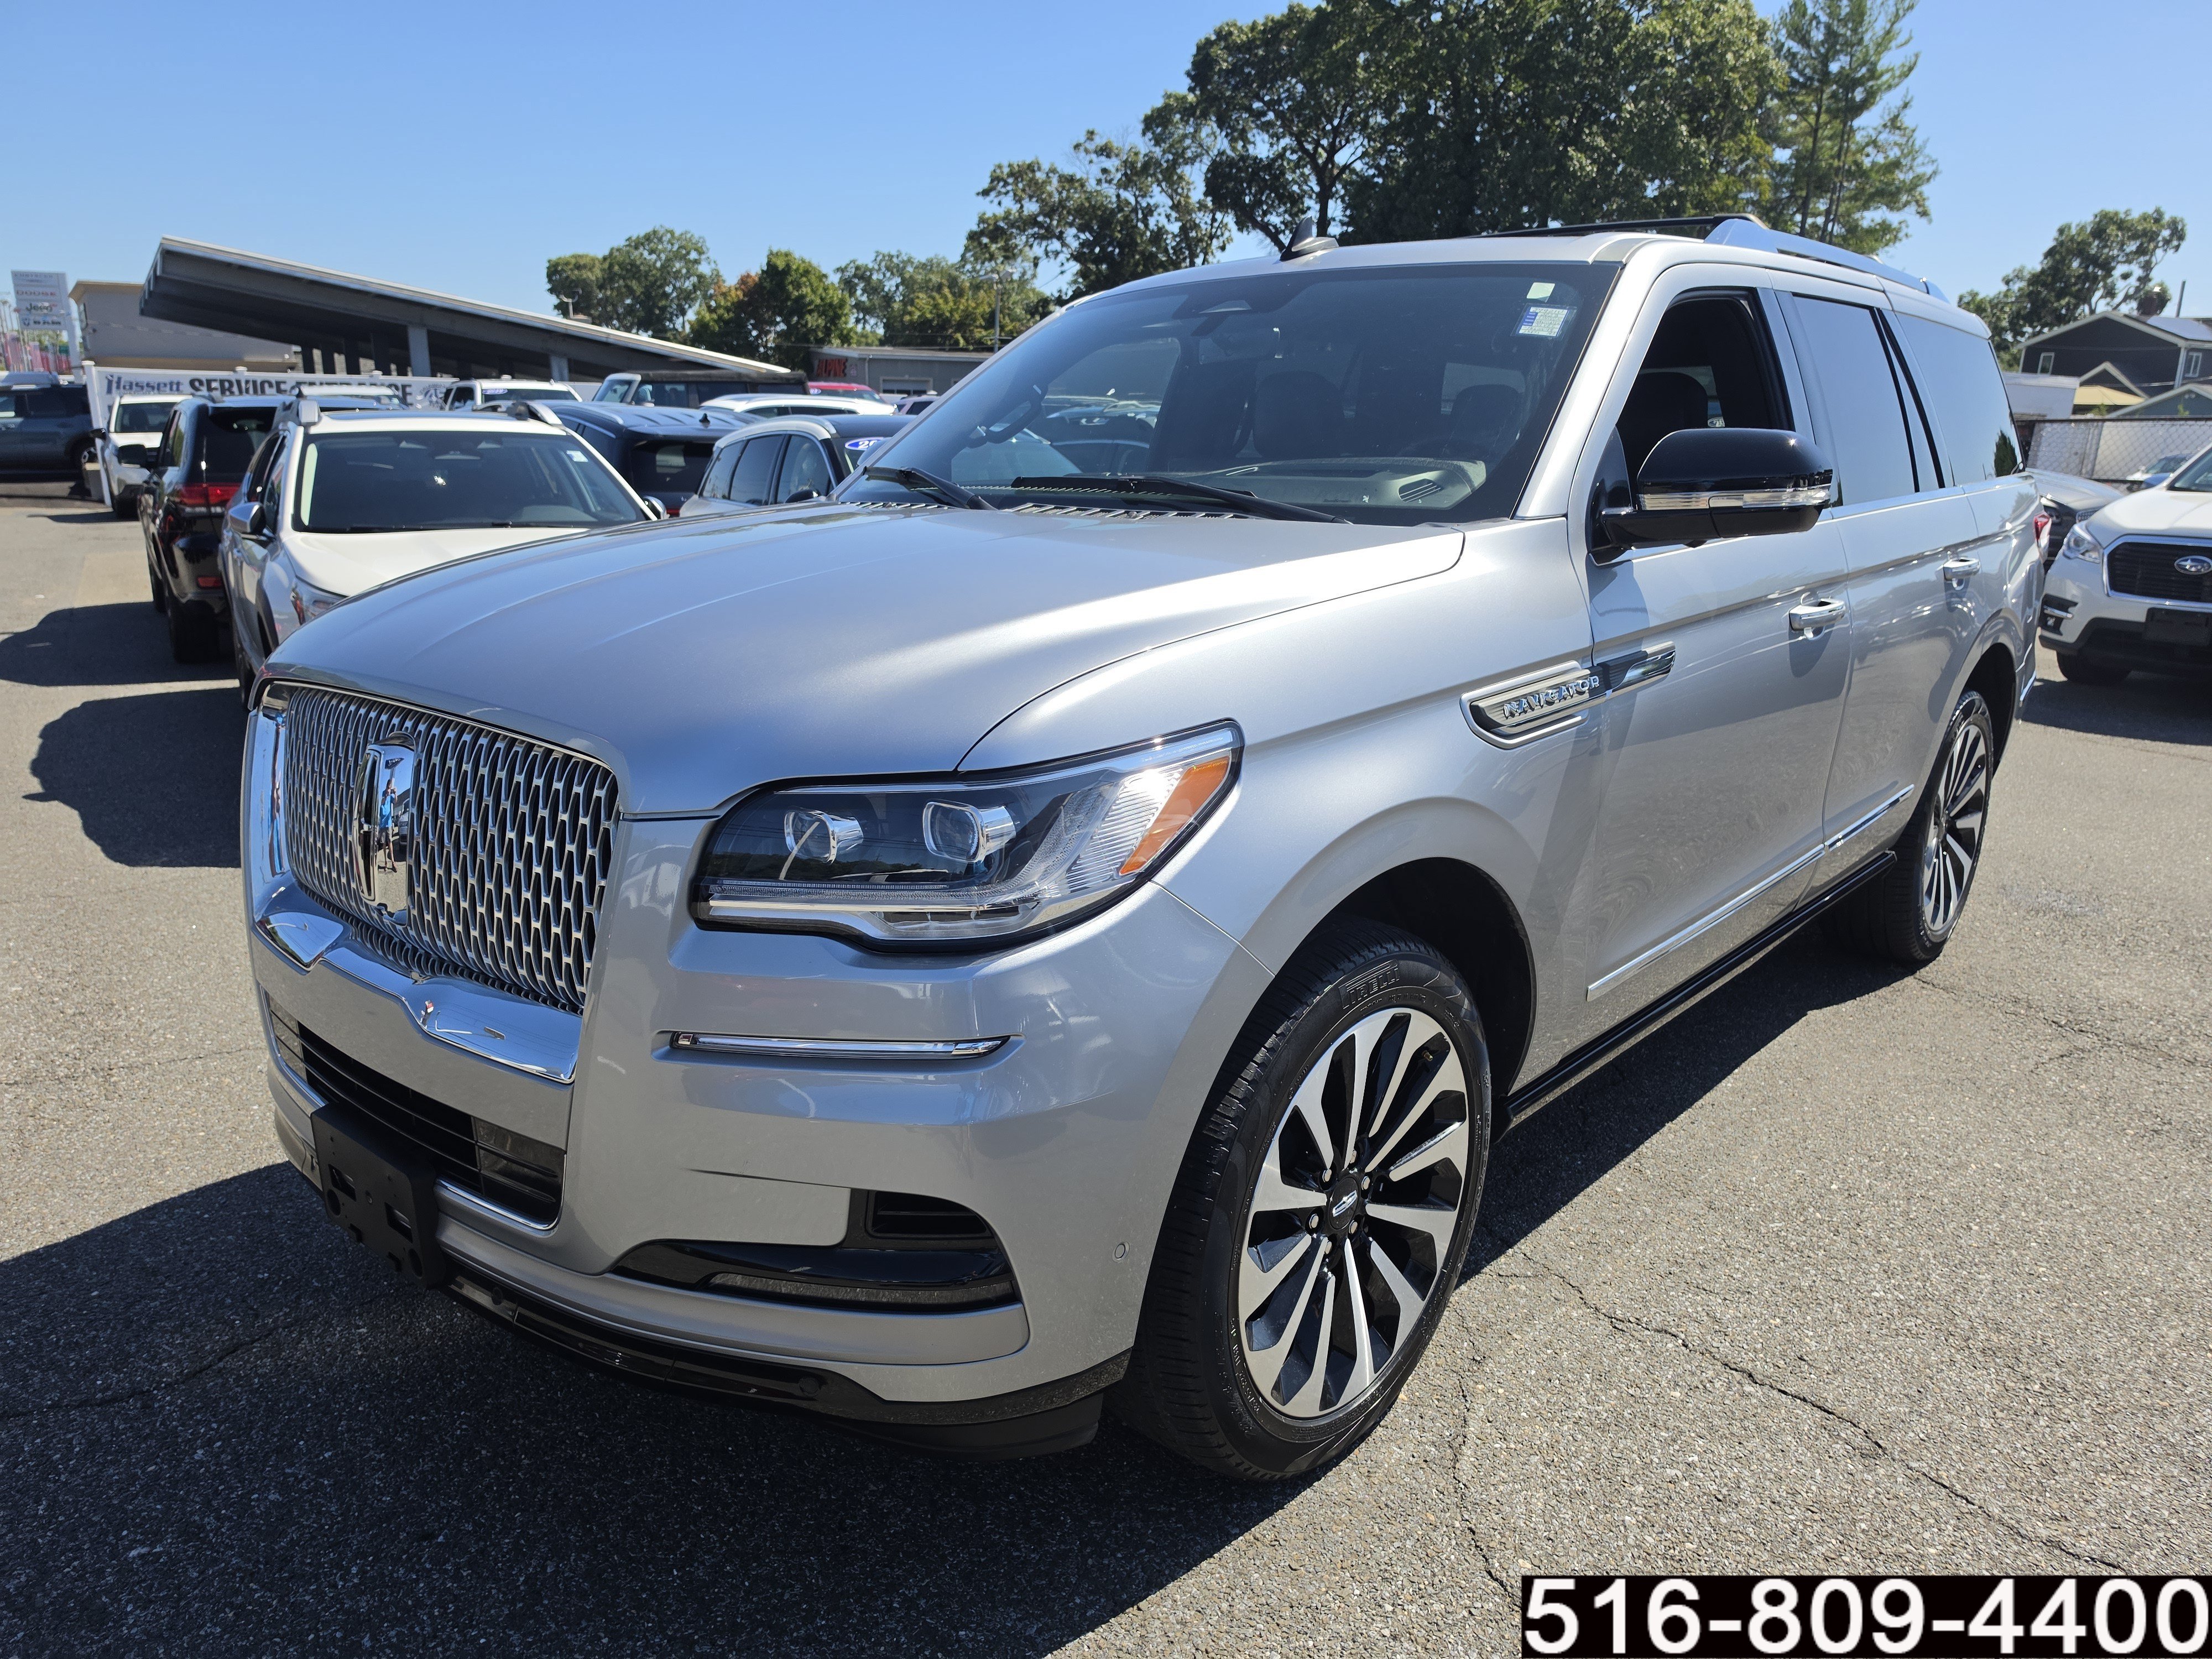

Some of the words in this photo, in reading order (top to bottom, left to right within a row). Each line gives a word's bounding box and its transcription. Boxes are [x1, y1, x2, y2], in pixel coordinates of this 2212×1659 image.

[189, 378, 288, 395] SERVICE
[1503, 675, 1600, 719] NAVIGATOR
[1338, 958, 1400, 1010] PIRELLI
